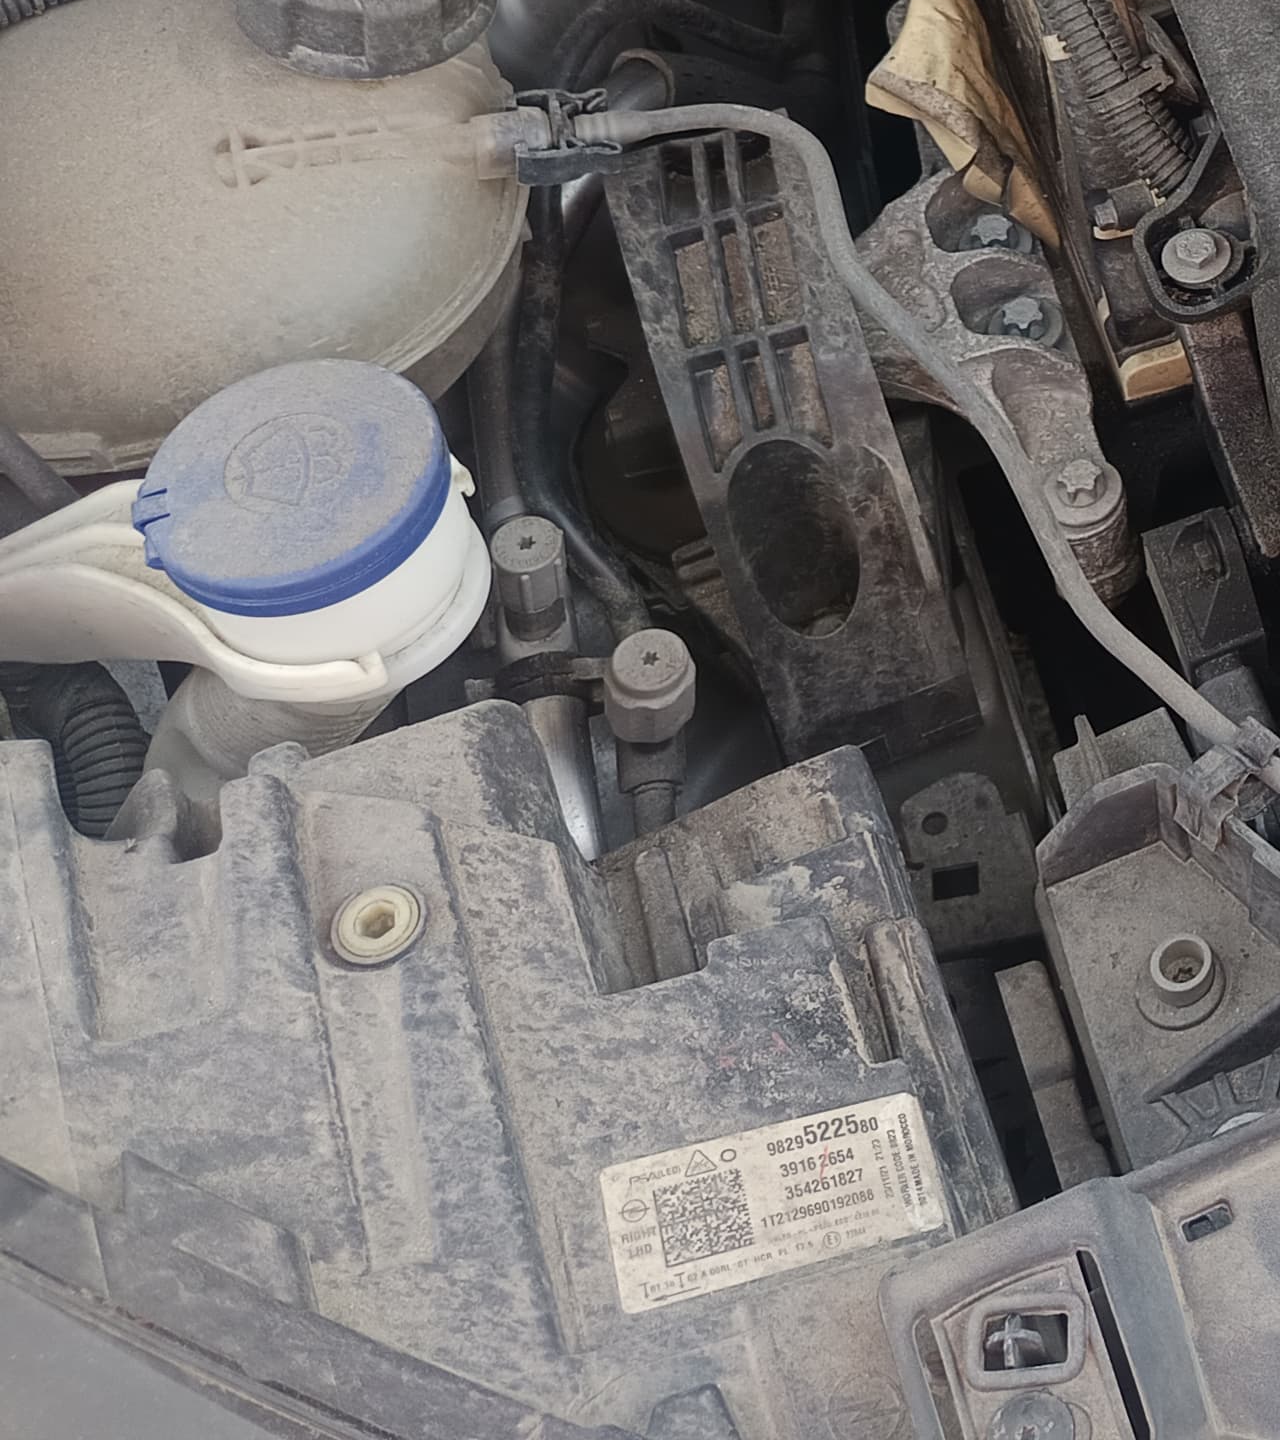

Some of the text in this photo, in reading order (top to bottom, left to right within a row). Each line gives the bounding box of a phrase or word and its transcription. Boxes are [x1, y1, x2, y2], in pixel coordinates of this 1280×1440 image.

[766, 1113, 879, 1157] 9829522580
[784, 1168, 863, 1201] 354261827
[760, 1188, 875, 1229] 1T2129690192088
